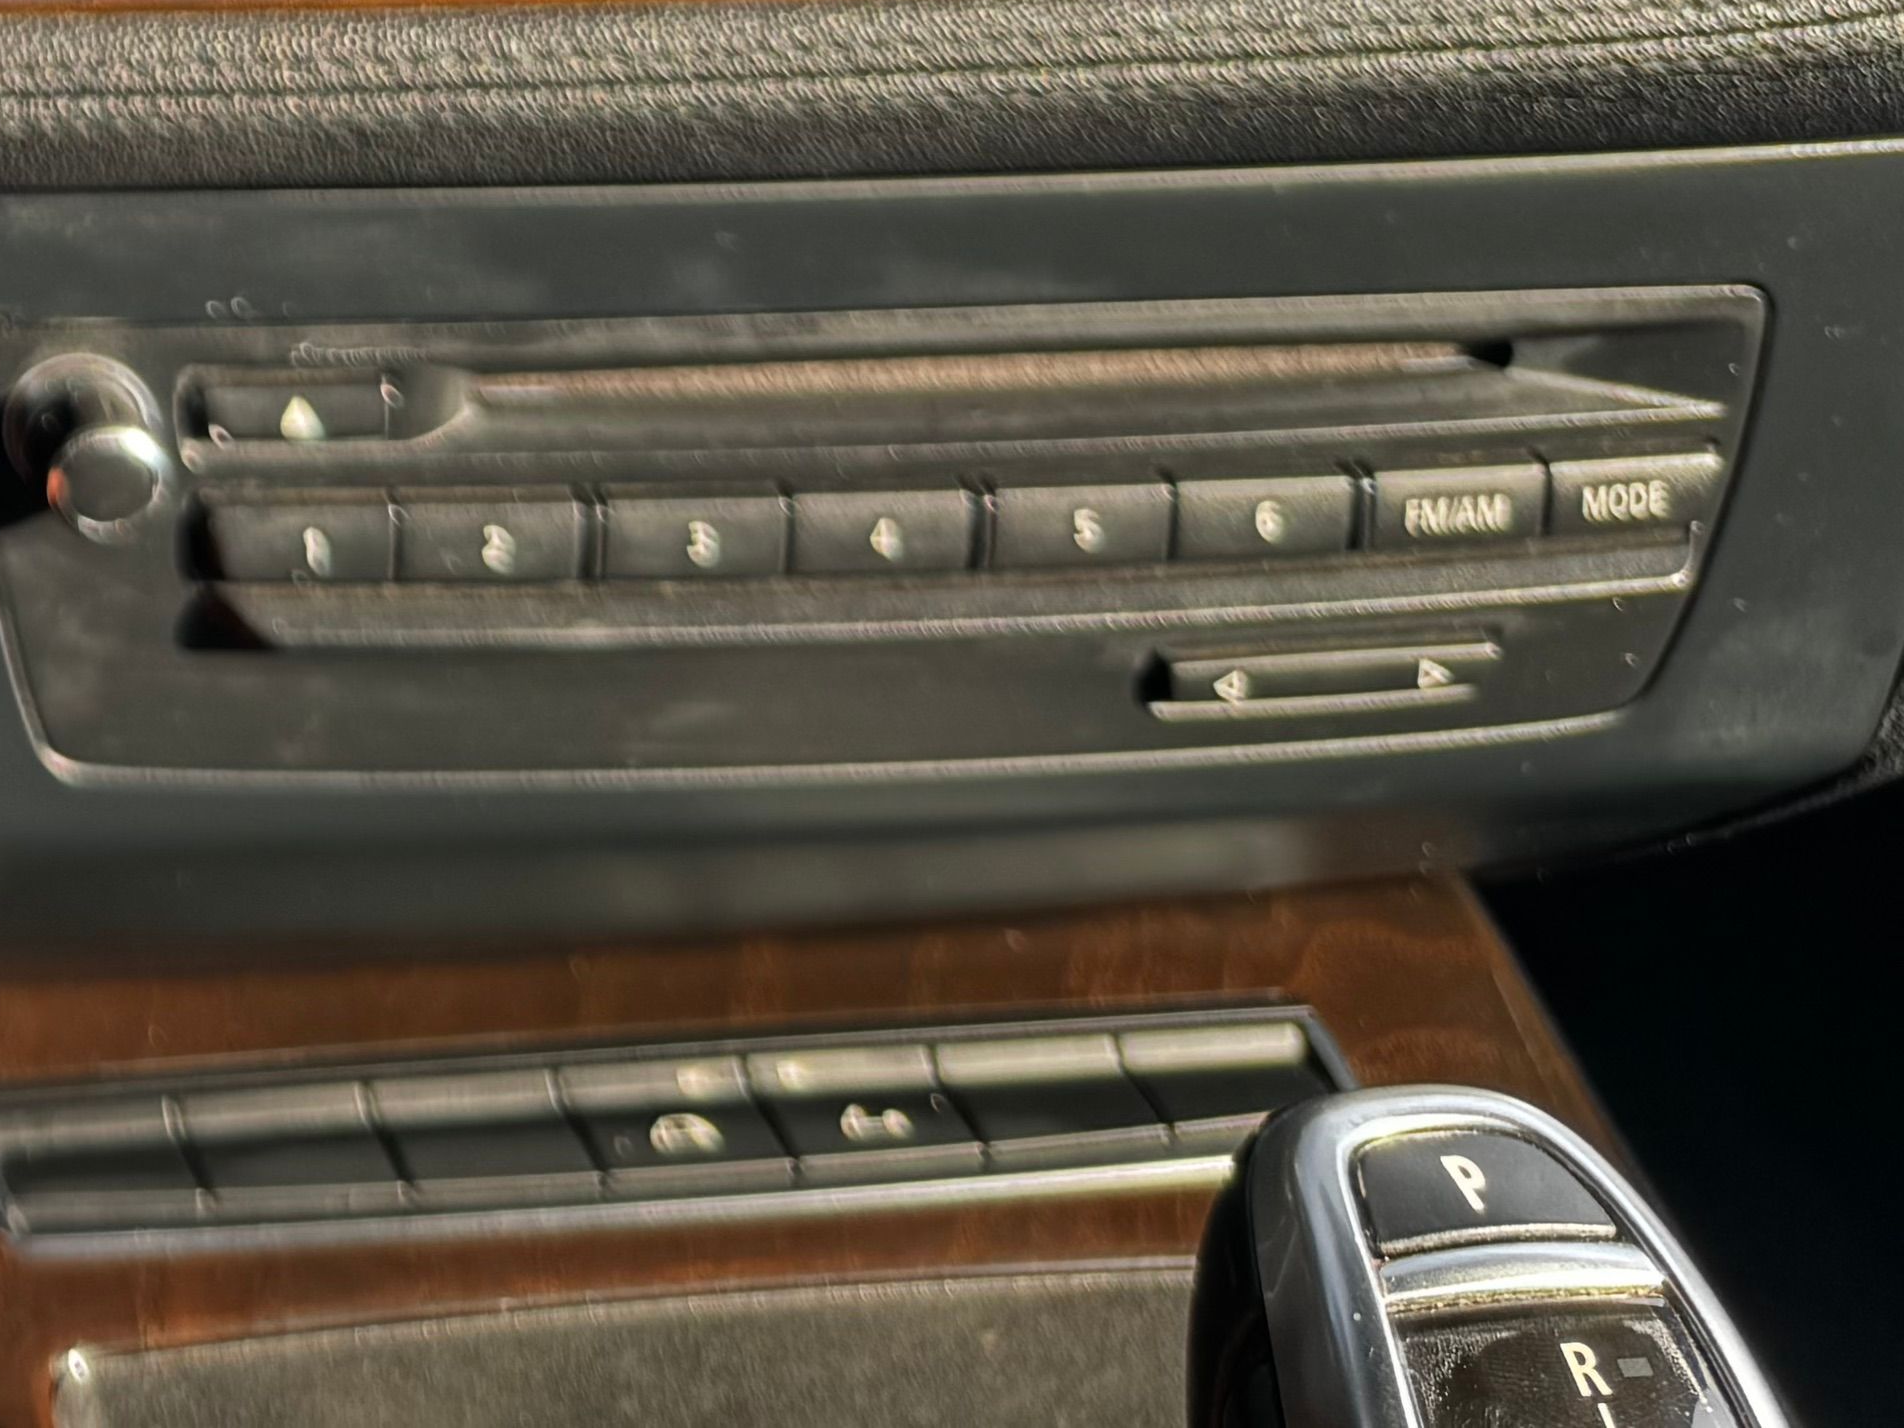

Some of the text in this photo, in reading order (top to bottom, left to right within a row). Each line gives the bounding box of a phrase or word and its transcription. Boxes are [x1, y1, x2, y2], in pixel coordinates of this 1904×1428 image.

[1255, 500, 1284, 545] 6
[1404, 493, 1512, 538] FM/AM
[1581, 480, 1671, 523] MODE
[481, 524, 517, 575] 2
[687, 520, 721, 569] 3
[1073, 508, 1104, 554] 5
[1439, 1154, 1488, 1214] P
[1560, 1341, 1614, 1398] R
